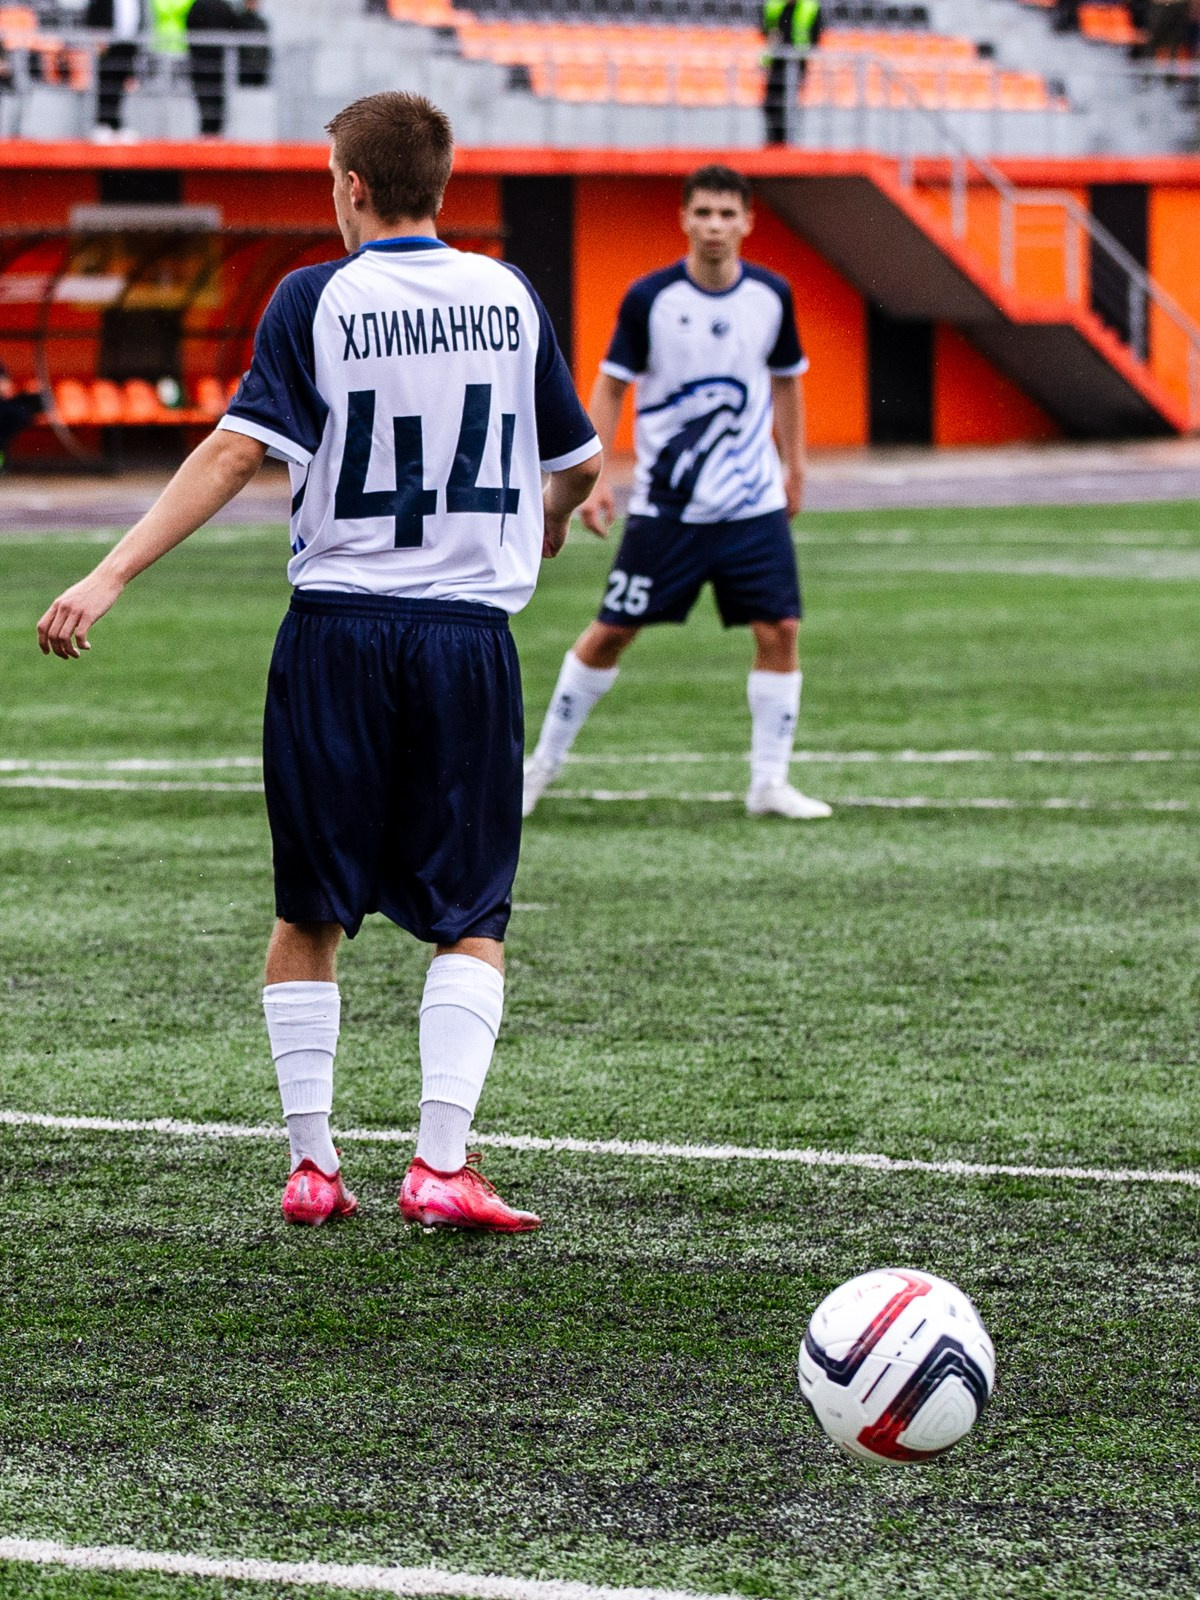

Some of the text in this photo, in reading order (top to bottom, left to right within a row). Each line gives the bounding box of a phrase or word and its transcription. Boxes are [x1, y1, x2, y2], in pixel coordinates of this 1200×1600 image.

[338, 305, 520, 361] ХЛИМАНКОВ
[334, 383, 521, 548] 44
[604, 569, 654, 616] 25
